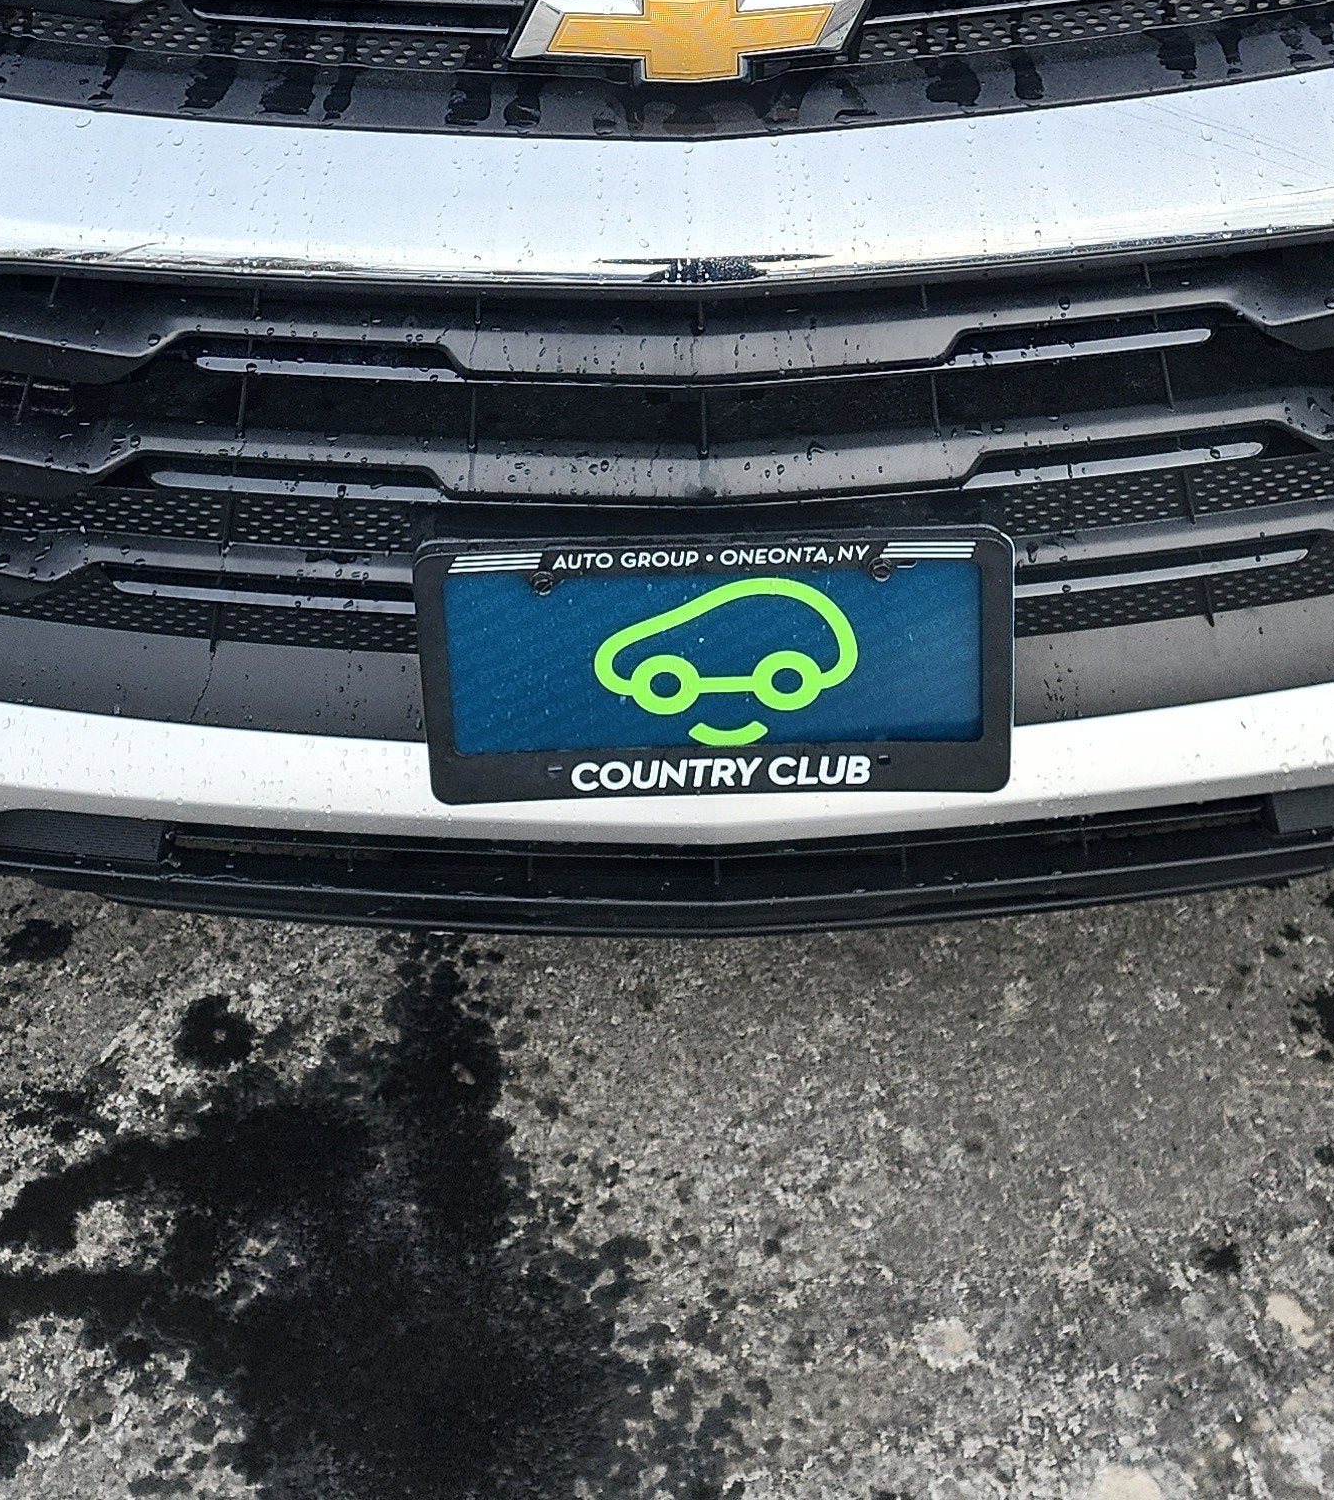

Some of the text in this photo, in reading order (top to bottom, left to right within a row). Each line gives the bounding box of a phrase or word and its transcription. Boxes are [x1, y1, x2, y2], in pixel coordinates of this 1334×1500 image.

[552, 553, 613, 570] AUTO
[620, 551, 699, 568] GROUP
[837, 545, 870, 562] NY
[571, 755, 871, 791] COUNTRY CLUB
